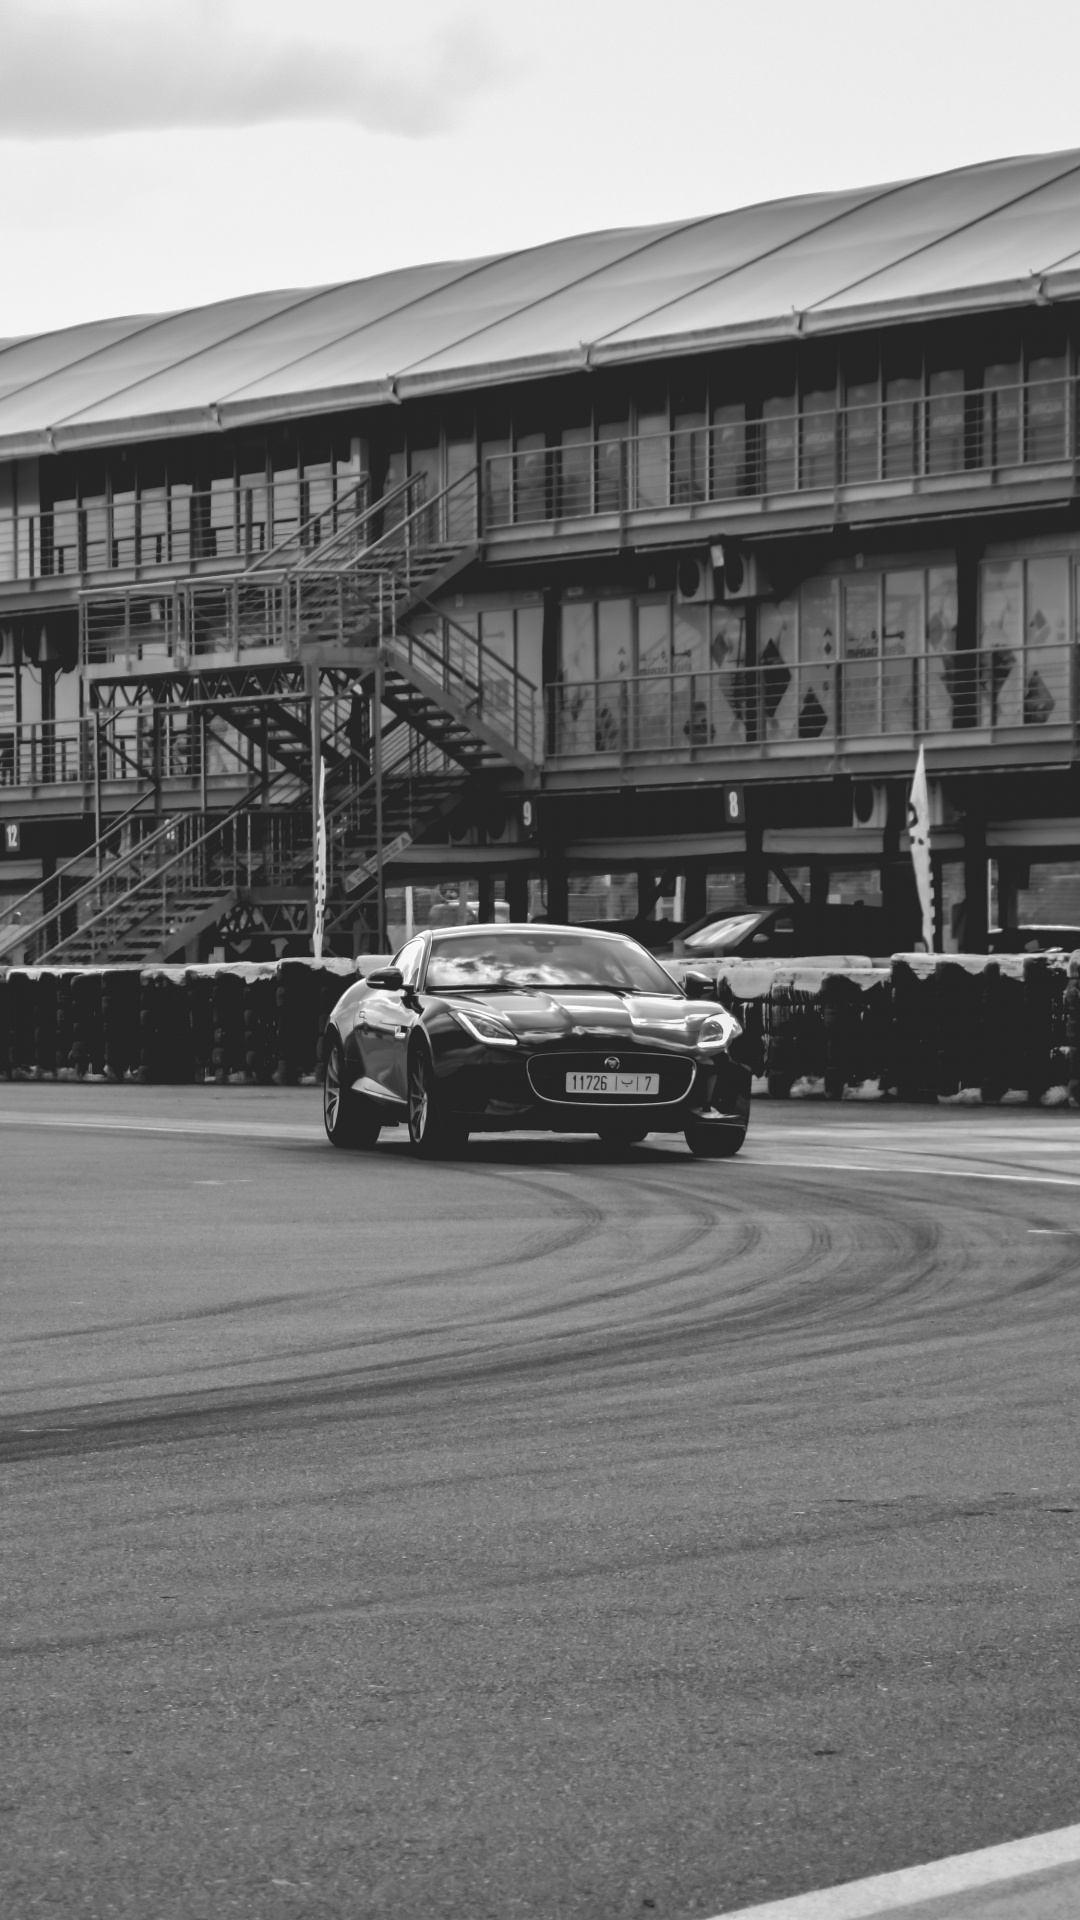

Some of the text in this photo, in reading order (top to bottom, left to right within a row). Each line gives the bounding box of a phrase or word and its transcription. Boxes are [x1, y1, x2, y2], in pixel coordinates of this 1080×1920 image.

[523, 801, 532, 826] 9
[729, 791, 738, 817] 8
[6, 824, 18, 847] 12
[572, 1075, 608, 1091] 11726
[645, 1076, 652, 1091] 7
